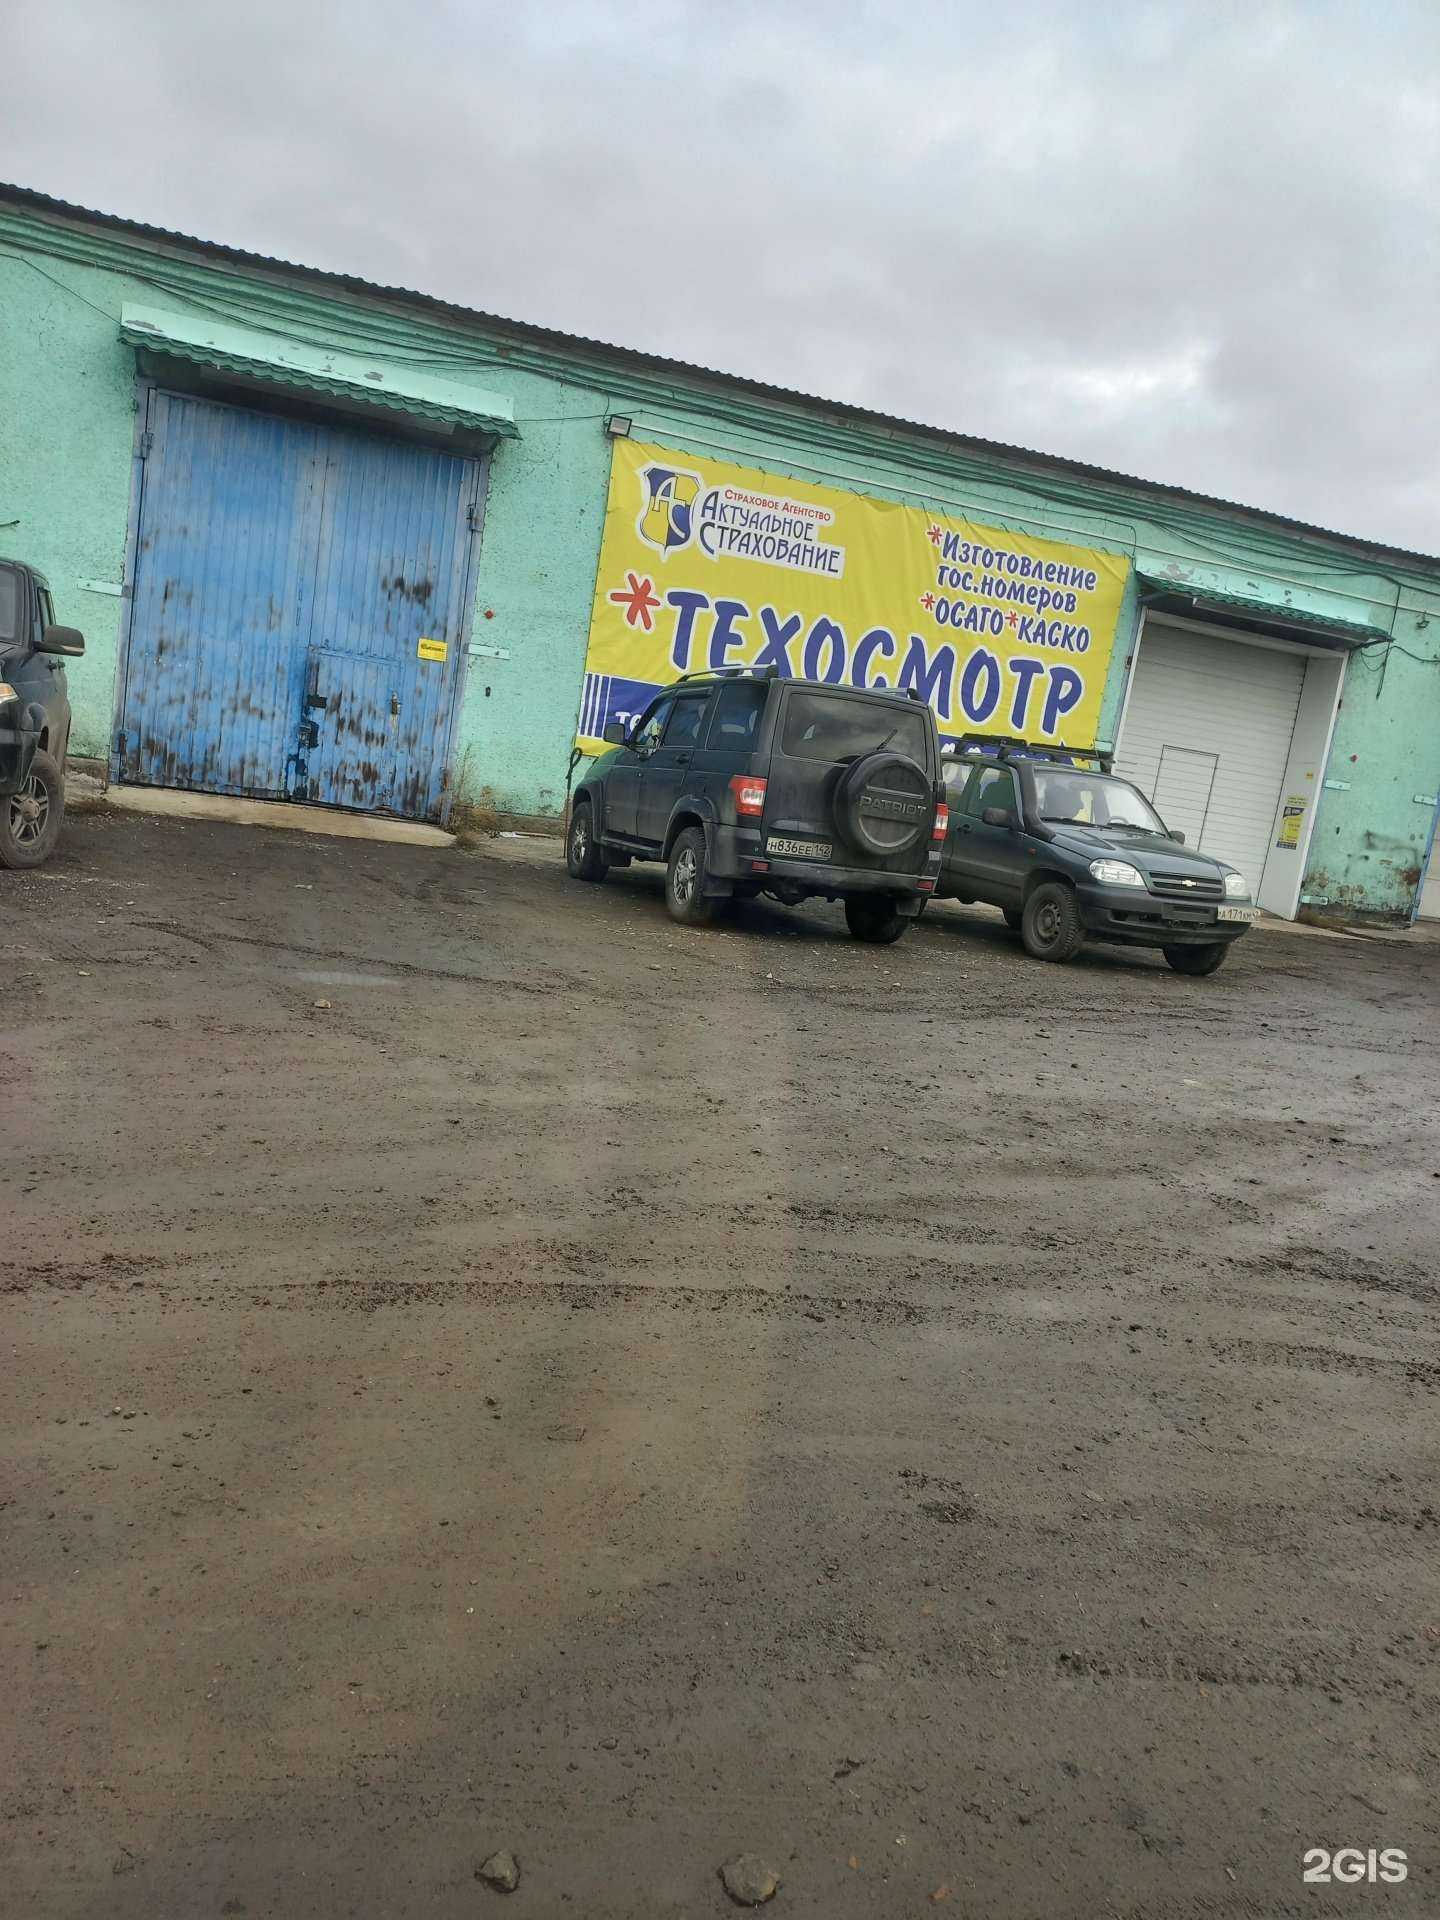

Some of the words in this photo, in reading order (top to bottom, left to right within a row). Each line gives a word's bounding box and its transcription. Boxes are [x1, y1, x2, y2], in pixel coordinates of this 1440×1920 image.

[701, 491, 814, 541] АКТУАЛЬНОЕ
[725, 489, 779, 511] СТРАХОВОЕ
[782, 502, 831, 521] АГЕНТСТВО
[699, 521, 840, 573] СТРАХОВАНИЕ
[942, 531, 1097, 591] Изготовление
[667, 591, 1083, 735] ТЕХОСМОТР
[860, 795, 927, 816] PATRIOT
